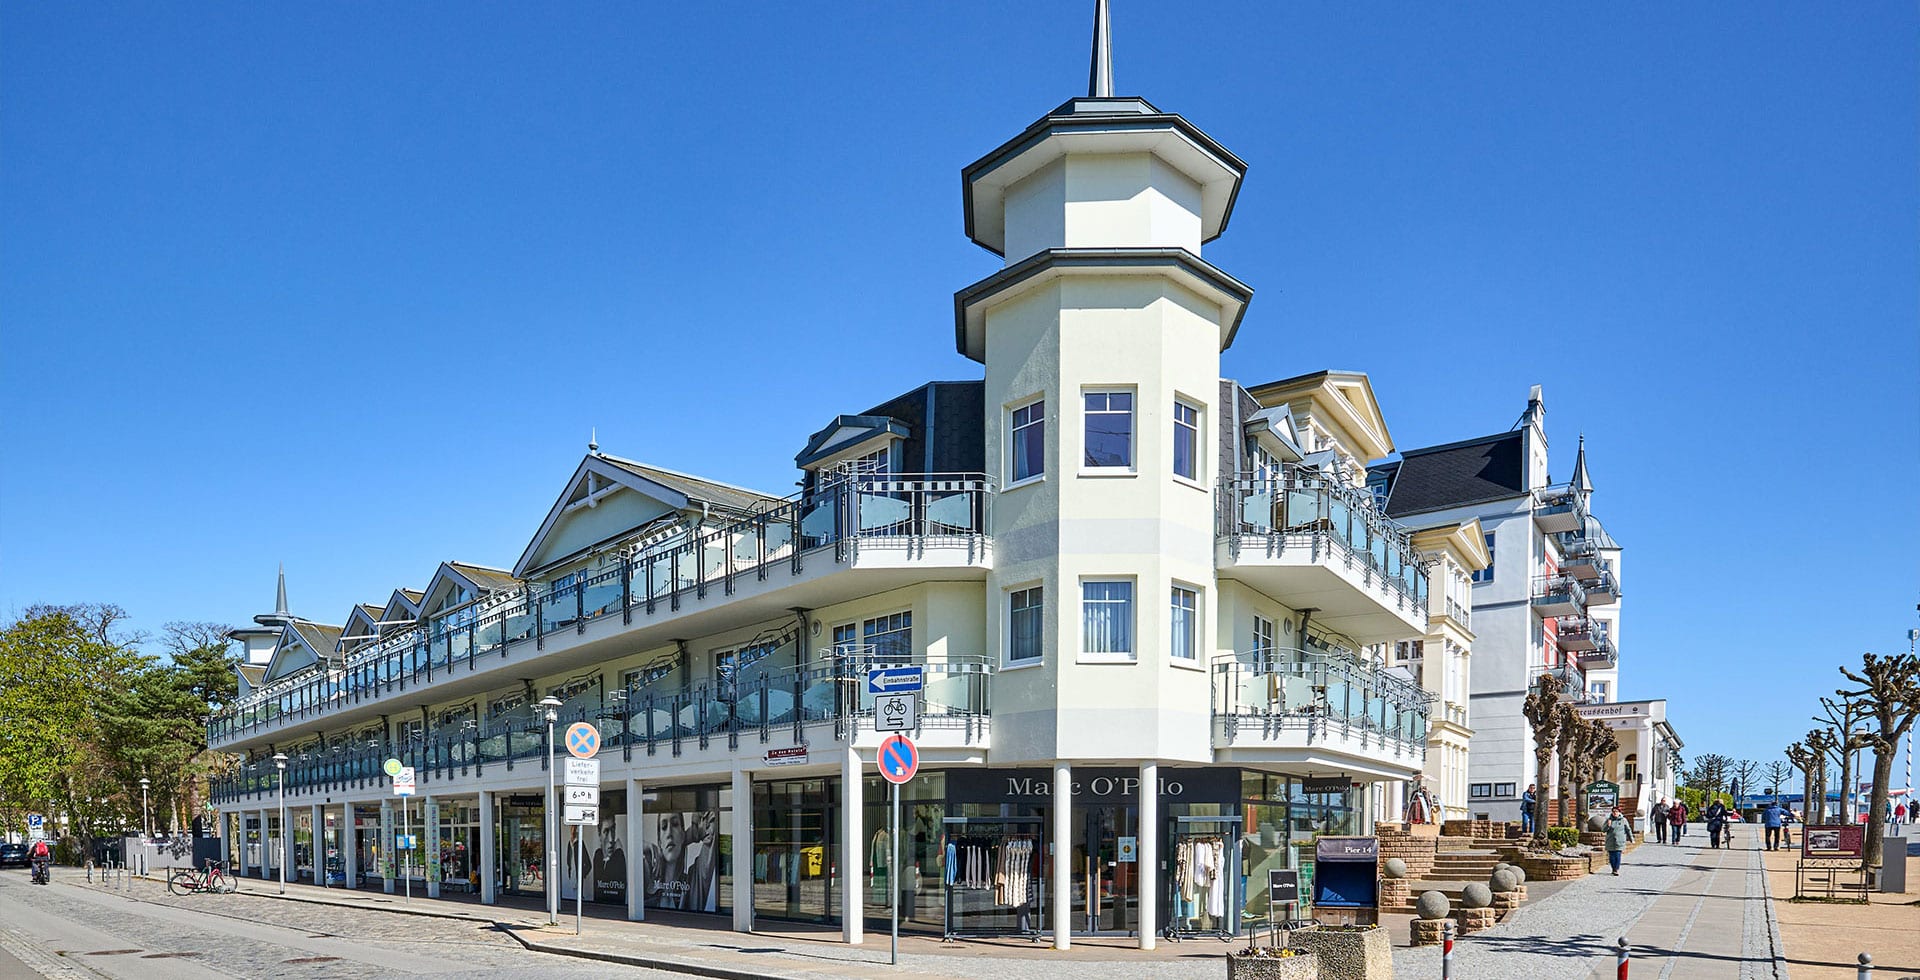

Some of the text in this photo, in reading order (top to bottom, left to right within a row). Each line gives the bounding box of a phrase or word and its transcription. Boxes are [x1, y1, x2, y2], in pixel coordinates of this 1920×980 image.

[884, 676, 919, 684] Einbahnstraße
[1580, 706, 1623, 716] reussenhof
[1006, 777, 1183, 796] Mac O'Plo
[597, 880, 625, 889] Marc O'Polo
[654, 880, 690, 891] Marc O'Polo
